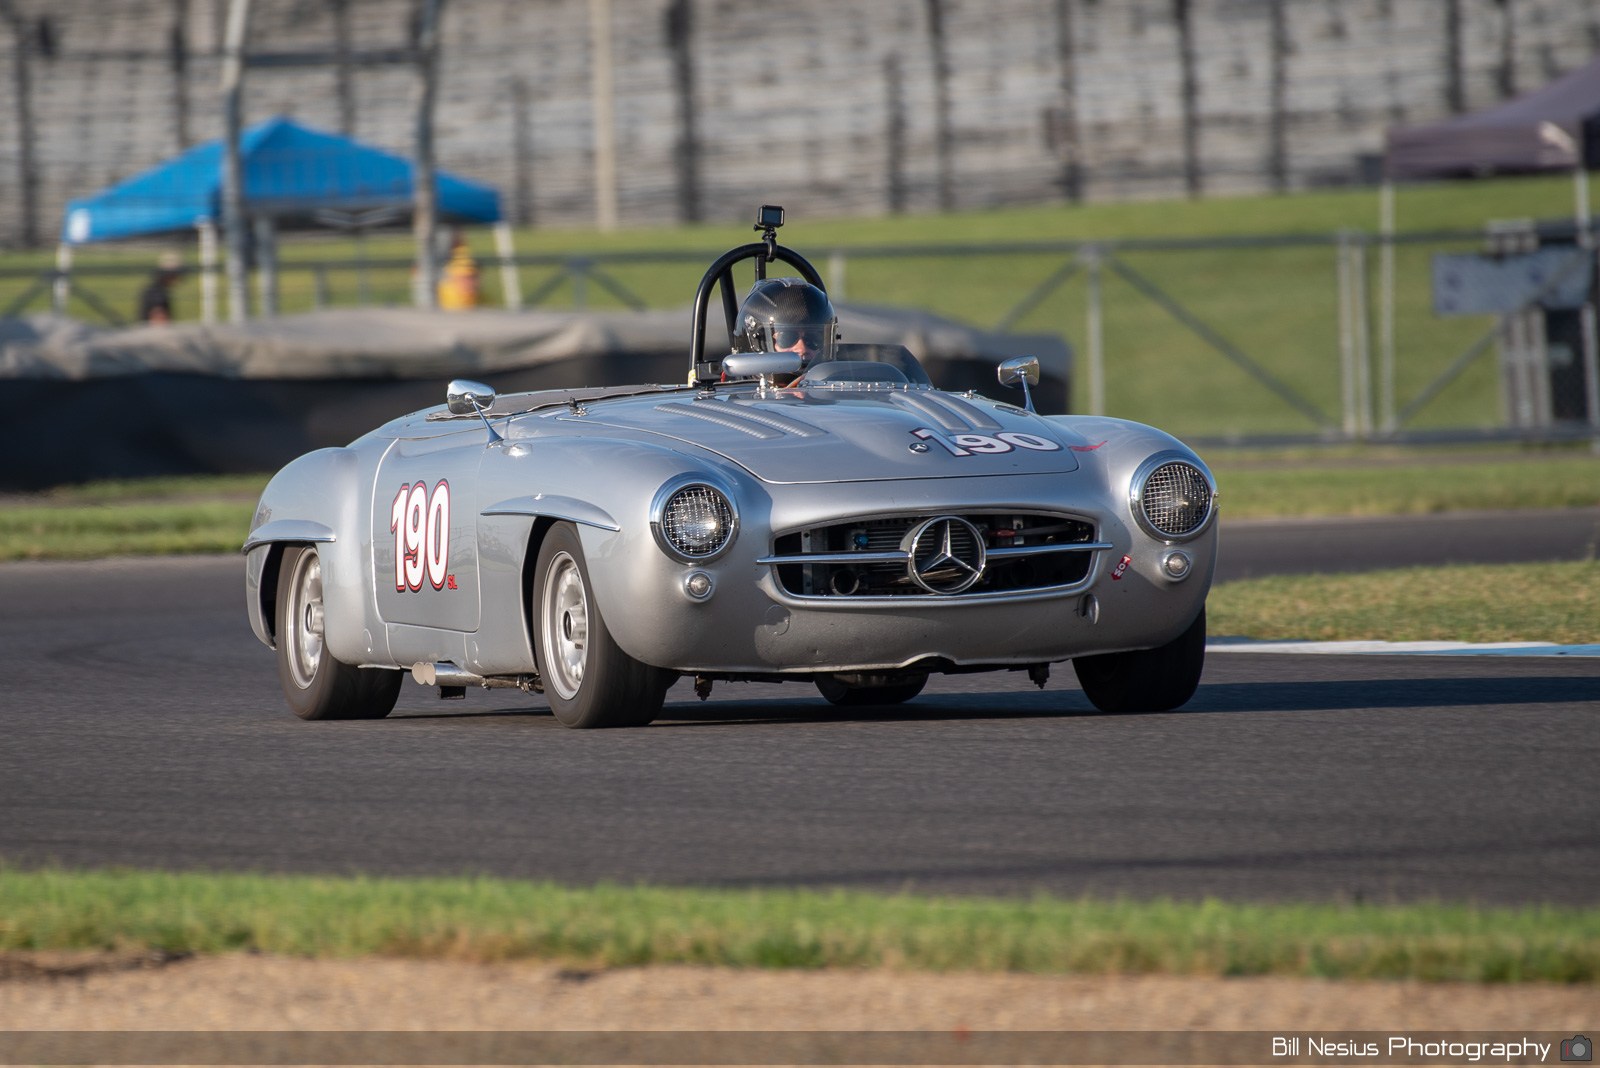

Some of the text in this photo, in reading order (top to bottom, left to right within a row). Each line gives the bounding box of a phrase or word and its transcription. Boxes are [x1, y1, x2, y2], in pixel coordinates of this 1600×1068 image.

[909, 427, 1064, 457] 190
[390, 478, 450, 593] 190
[1113, 556, 1131, 577] TOW
[447, 574, 458, 590] SL
